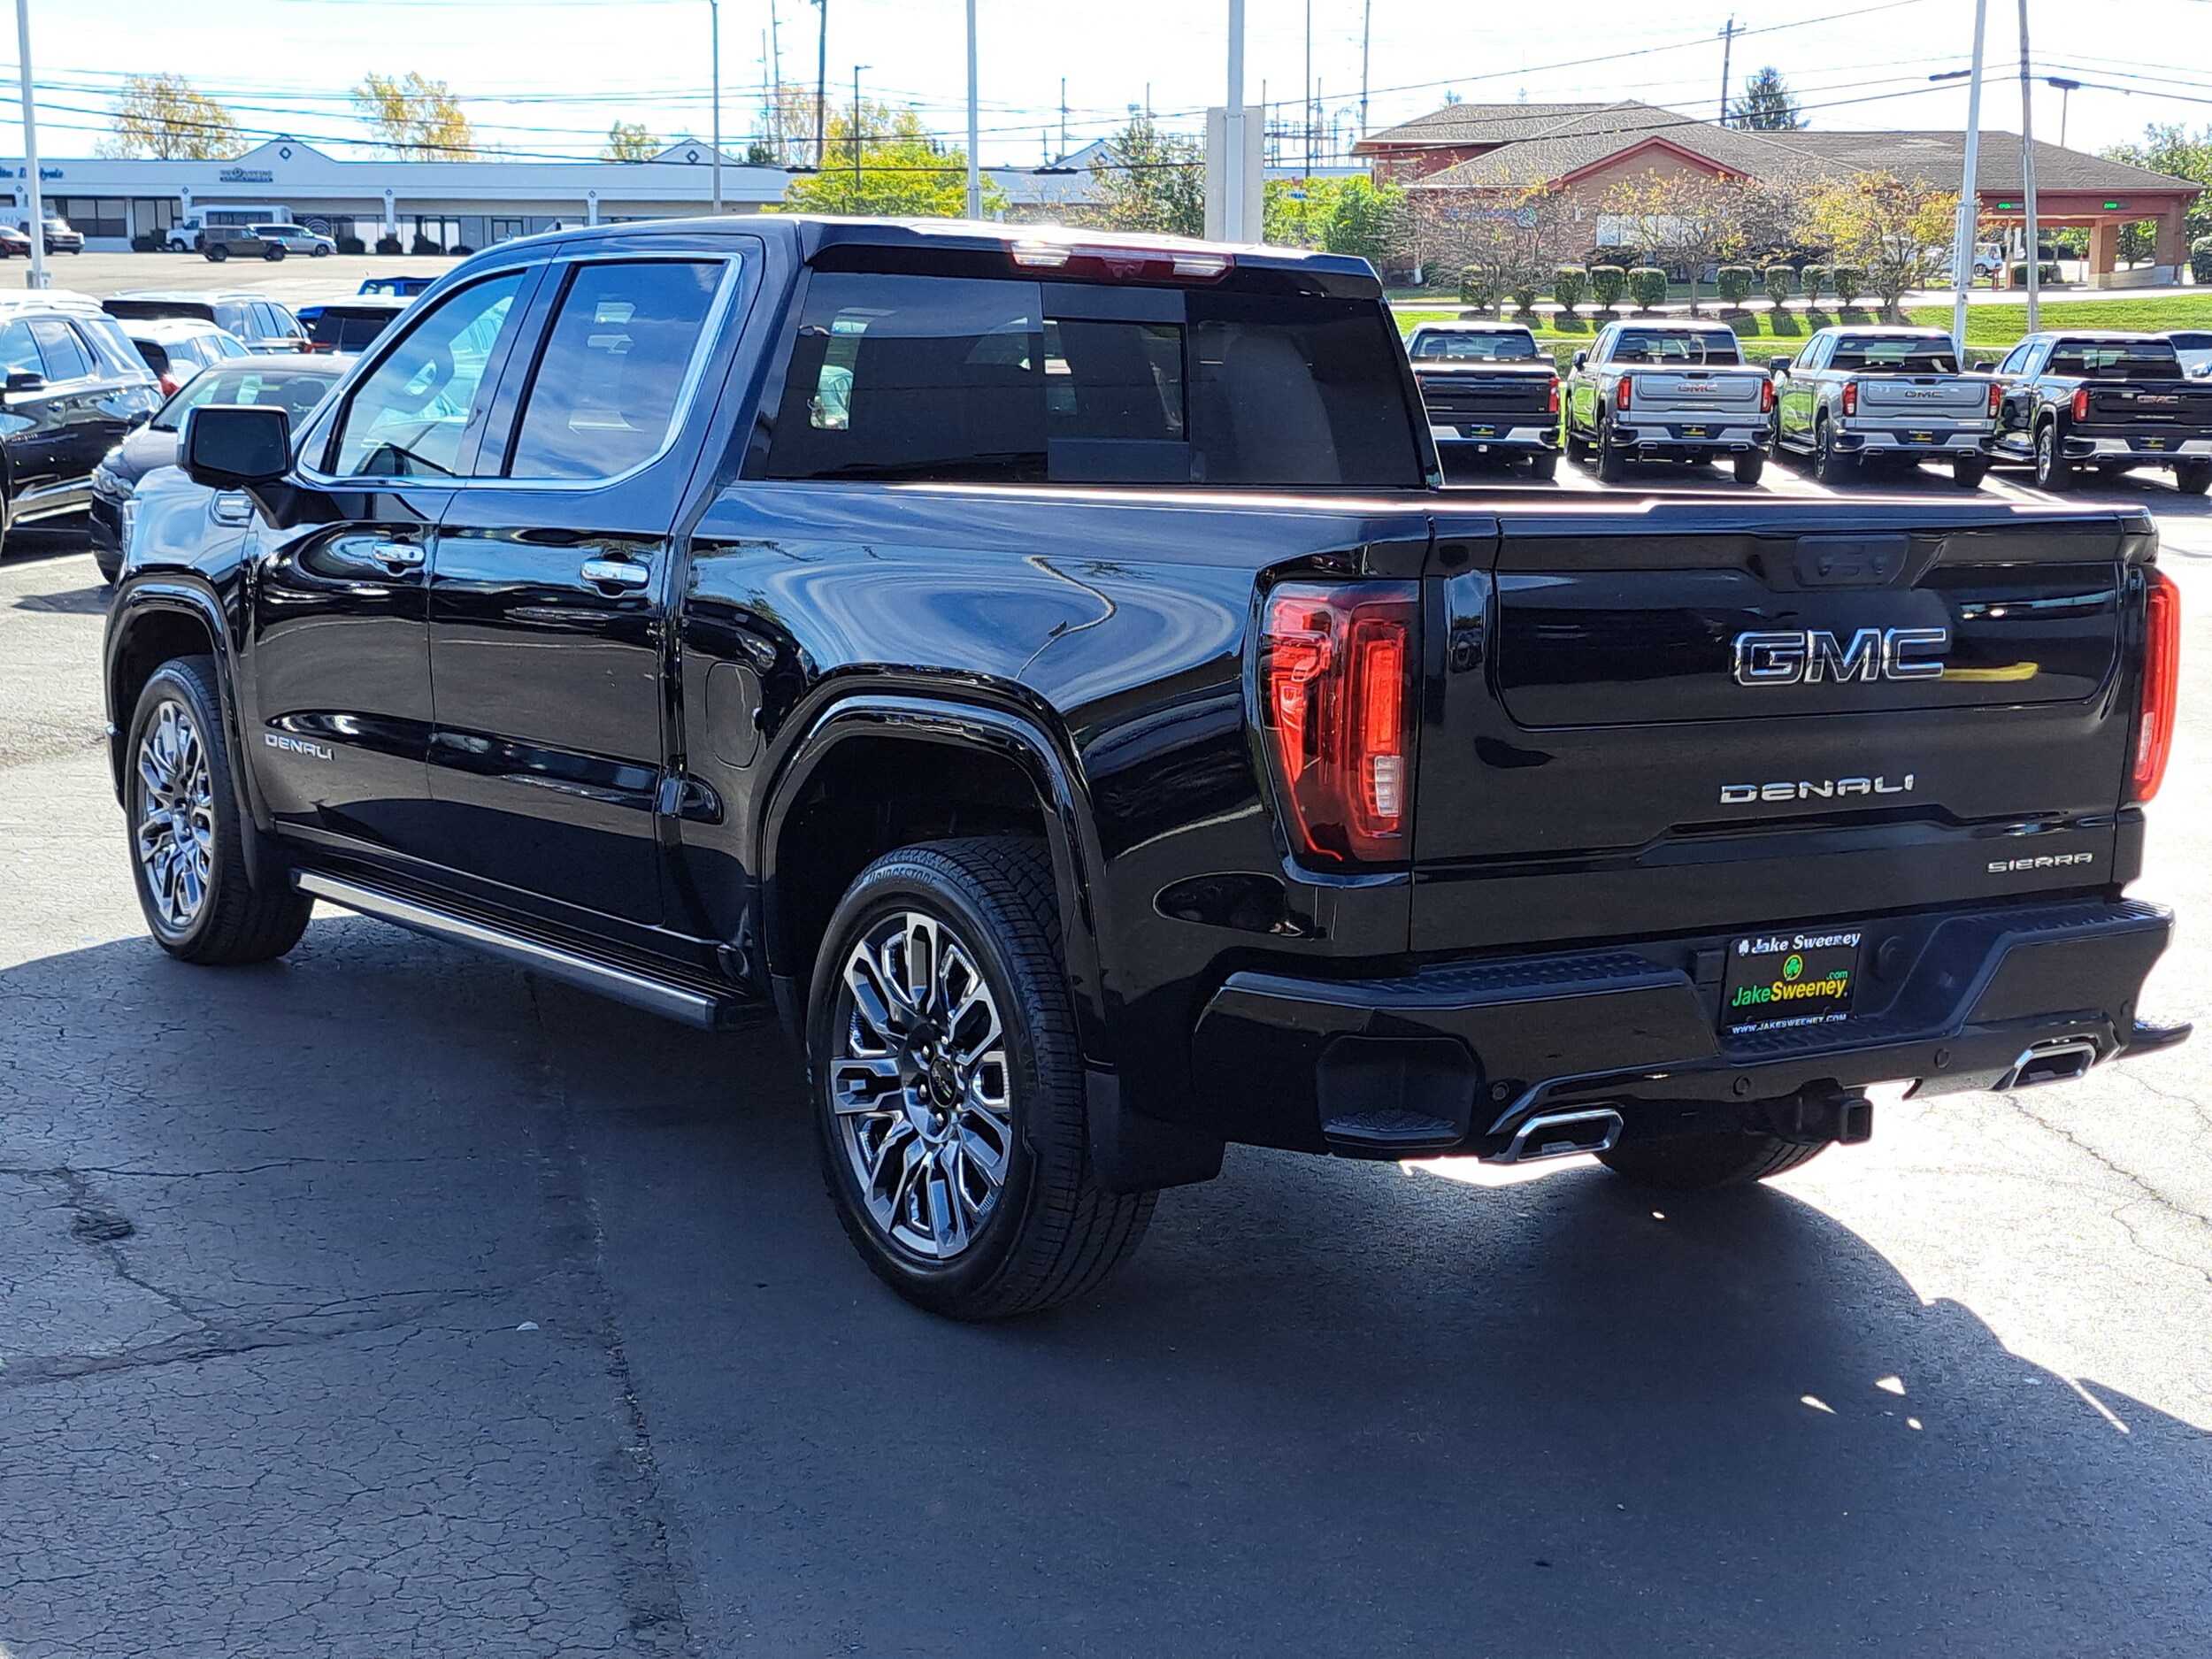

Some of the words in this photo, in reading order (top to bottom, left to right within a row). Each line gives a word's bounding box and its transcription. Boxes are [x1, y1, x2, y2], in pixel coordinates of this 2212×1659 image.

[1735, 627, 1947, 687] GMC
[265, 733, 334, 761] DENALI
[1720, 773, 1915, 803] DENALI
[1987, 852, 2093, 873] SIERRA
[1751, 938, 1789, 954] Jake
[1793, 933, 1862, 950] Sweeney
[1732, 979, 1847, 1007] JakeSweeney
